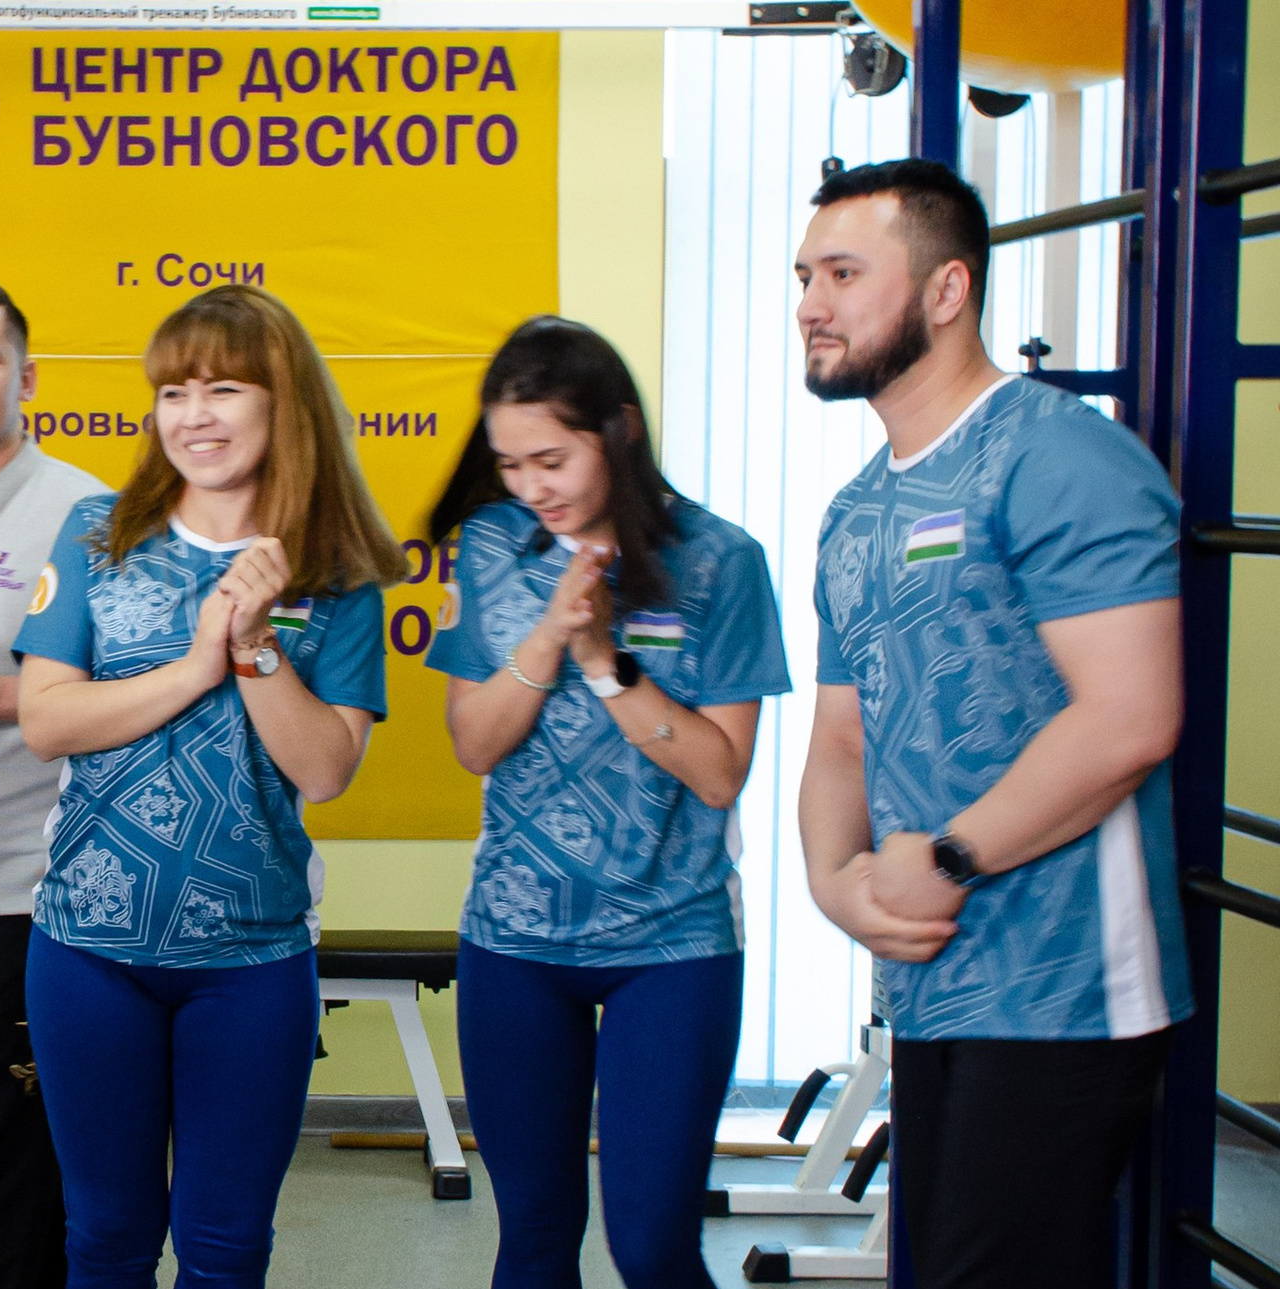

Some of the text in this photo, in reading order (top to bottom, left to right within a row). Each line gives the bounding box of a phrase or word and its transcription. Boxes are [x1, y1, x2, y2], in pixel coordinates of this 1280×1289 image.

[212, 6, 298, 21] Бубновского
[32, 45, 517, 103] ЦЕНТР ДОКТОРА
[33, 113, 518, 168] БУБНОВСКОГО
[117, 252, 265, 287] г. Сочи
